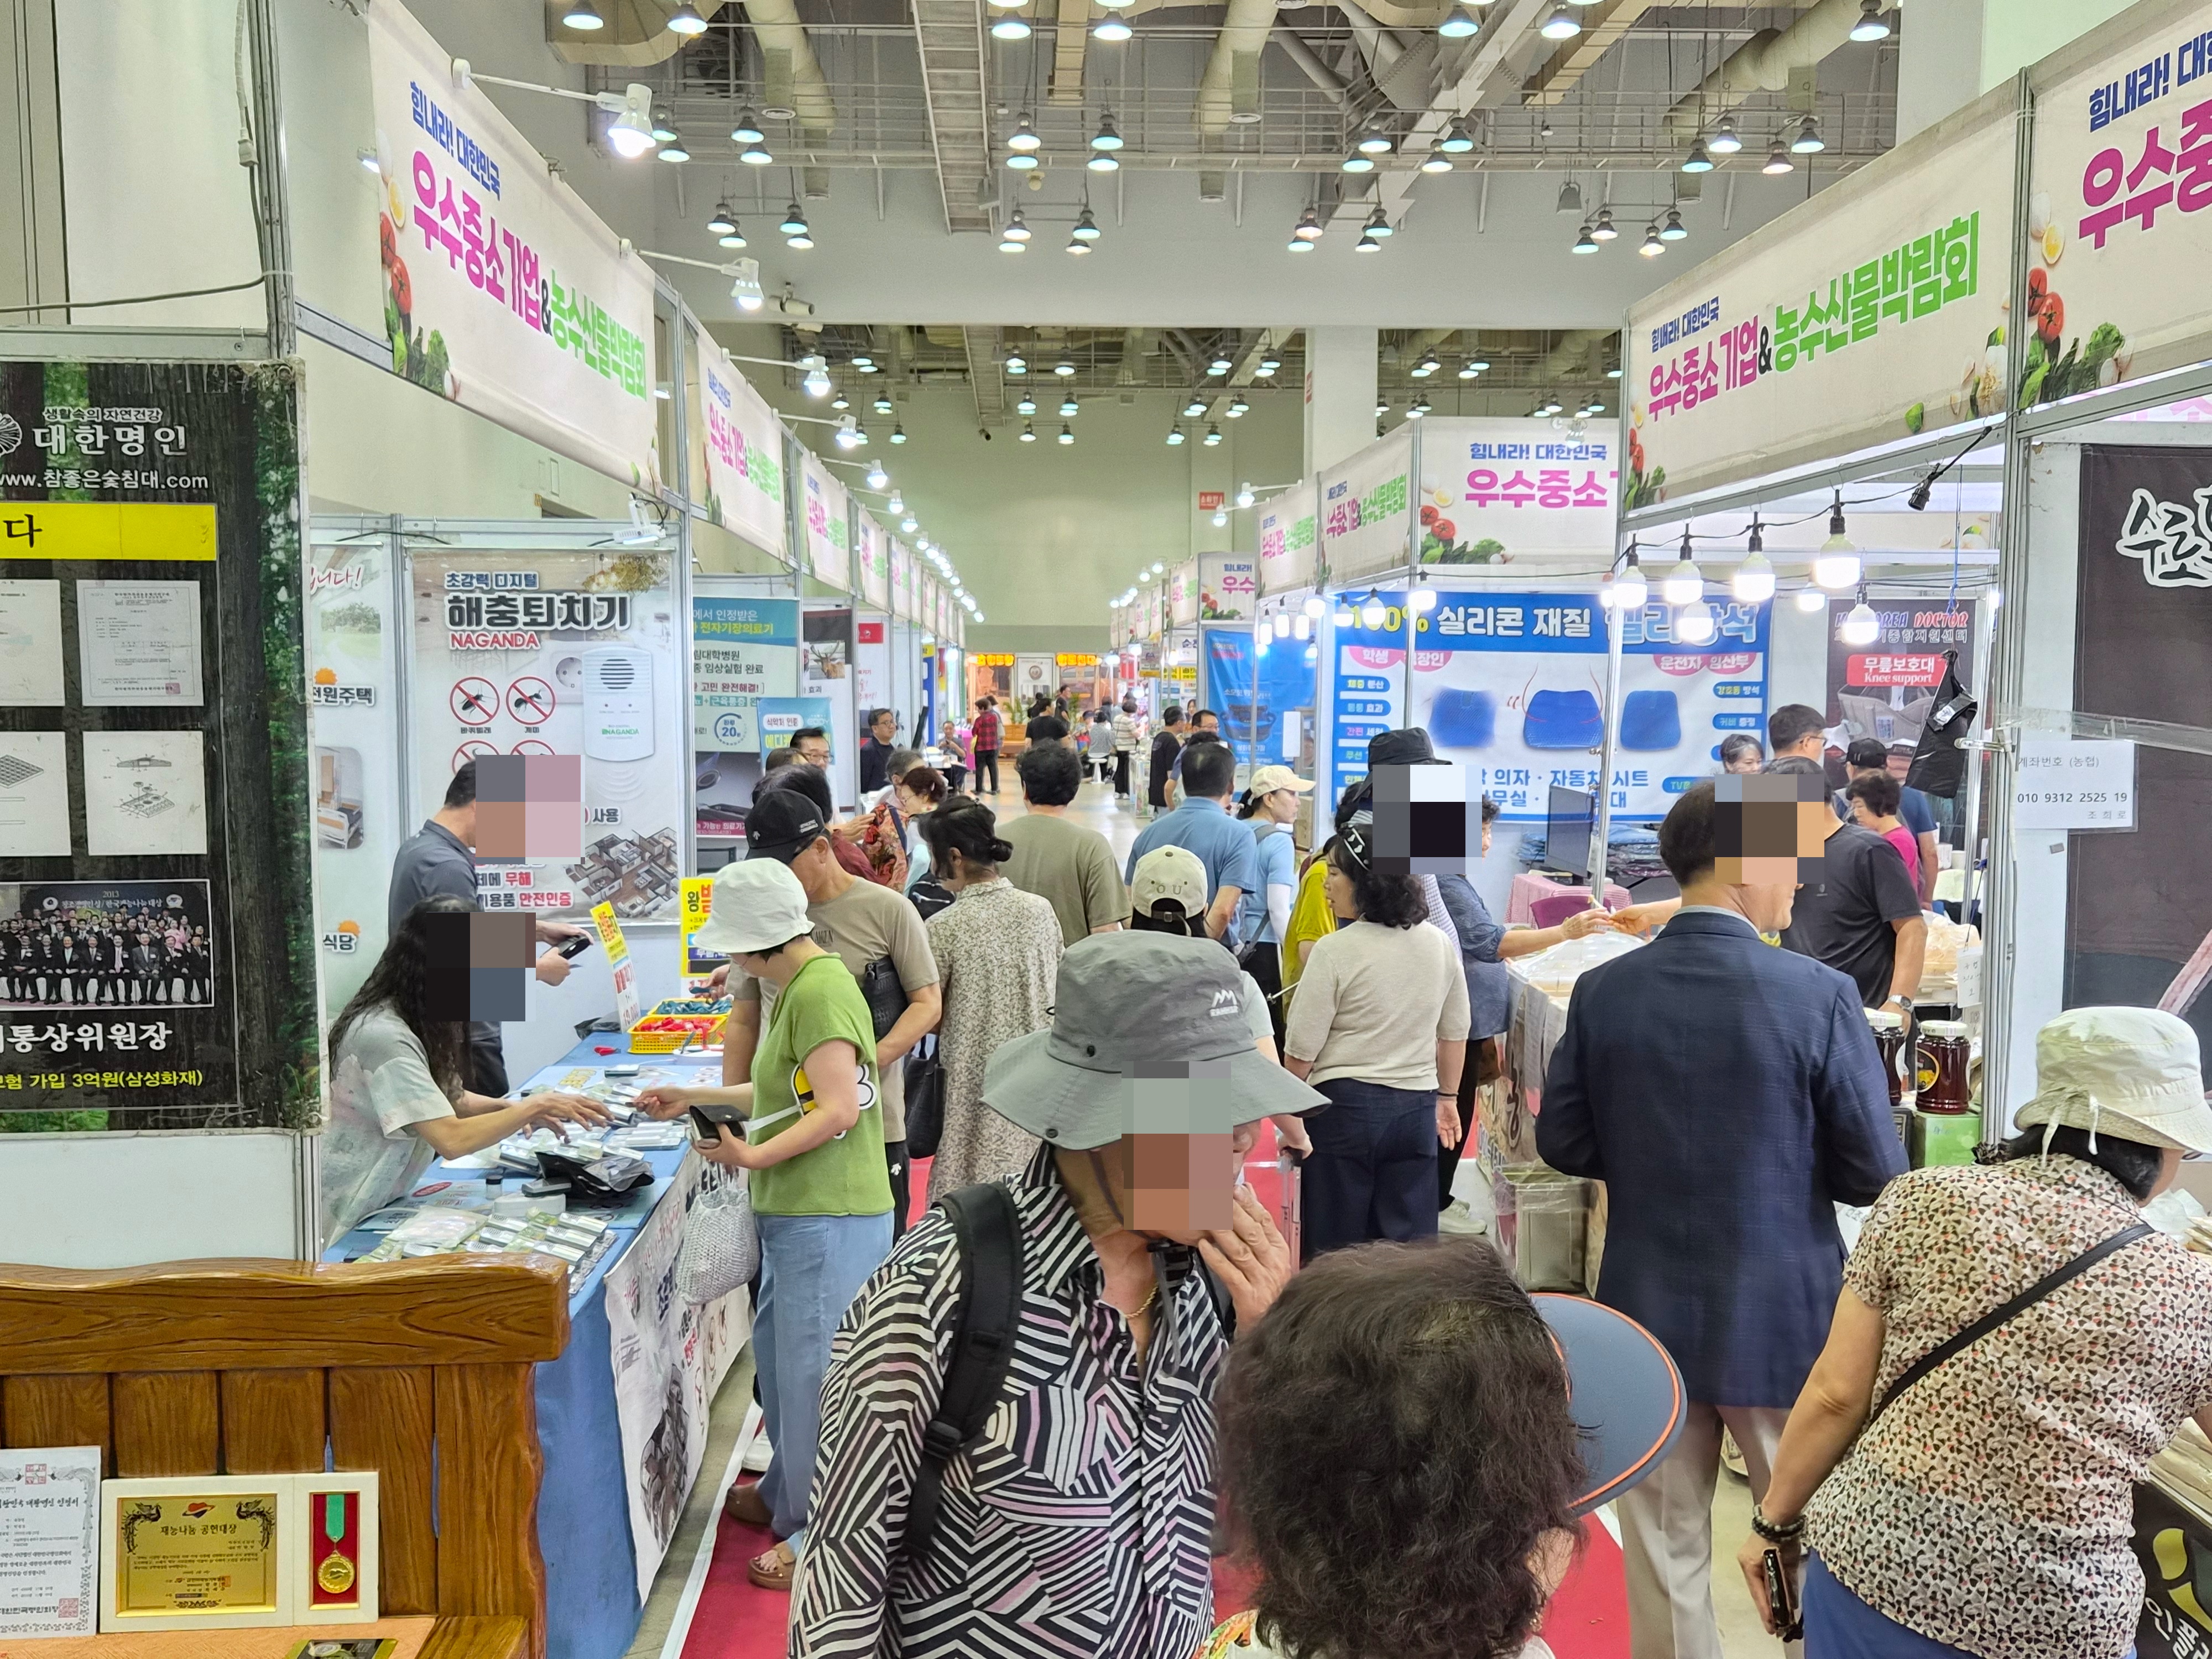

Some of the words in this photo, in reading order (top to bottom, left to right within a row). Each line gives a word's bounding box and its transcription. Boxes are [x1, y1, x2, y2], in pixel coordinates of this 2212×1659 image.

[2090, 52, 2171, 133] 힘내라!
[2177, 32, 2212, 87] 대
[410, 81, 454, 158] 힘내라!
[456, 127, 500, 201] 대한민국
[1652, 317, 1680, 353] 힘내라!
[1682, 296, 1719, 338] 대한민국
[43, 407, 102, 422] 생활속의
[103, 407, 163, 423] 자연건강
[33, 425, 187, 456] 대한명인
[1470, 442, 1530, 460] 힘내라!
[1535, 444, 1607, 461] 대한민국
[1465, 469, 1619, 508] 우수중소
[4, 514, 43, 548] 다
[446, 573, 489, 588] 초강력
[494, 573, 537, 588] 디지털
[447, 594, 628, 628] 해충퇴치기
[716, 610, 758, 622] 인정받은
[700, 622, 774, 635] 전자기장의료기
[1350, 605, 1429, 633] 10%
[1437, 606, 1524, 636] 실리콘
[1533, 608, 1591, 637] 재질
[451, 633, 539, 648] NAGANDA
[1363, 649, 1389, 663] 학생
[1661, 656, 1702, 670] 운전자
[1710, 655, 1749, 670] 임산부
[705, 664, 742, 674] 임상실험
[745, 664, 764, 674] 완료
[1864, 657, 1934, 672] 무릎보호대
[1864, 672, 1891, 683] Knee
[1892, 674, 1933, 685] support
[701, 683, 718, 692] 고민
[2018, 757, 2063, 768] 계좌번호
[2069, 756, 2099, 768] (농협)
[1494, 769, 1531, 786] 의자
[1612, 770, 1649, 787] 시트
[1485, 790, 1527, 807] 무실
[2017, 794, 2038, 803] 010
[2045, 793, 2073, 802] 9312
[2079, 793, 2107, 802] 2525
[2115, 792, 2127, 802] 19
[593, 808, 619, 823] 사용
[505, 872, 531, 886] 무해
[519, 891, 572, 907] 안전인증
[323, 933, 354, 951] 식당
[0, 1022, 173, 1053] 통상위원장
[30, 1073, 66, 1090] 가입
[72, 1069, 203, 1088] 3억원(삼성화재)
